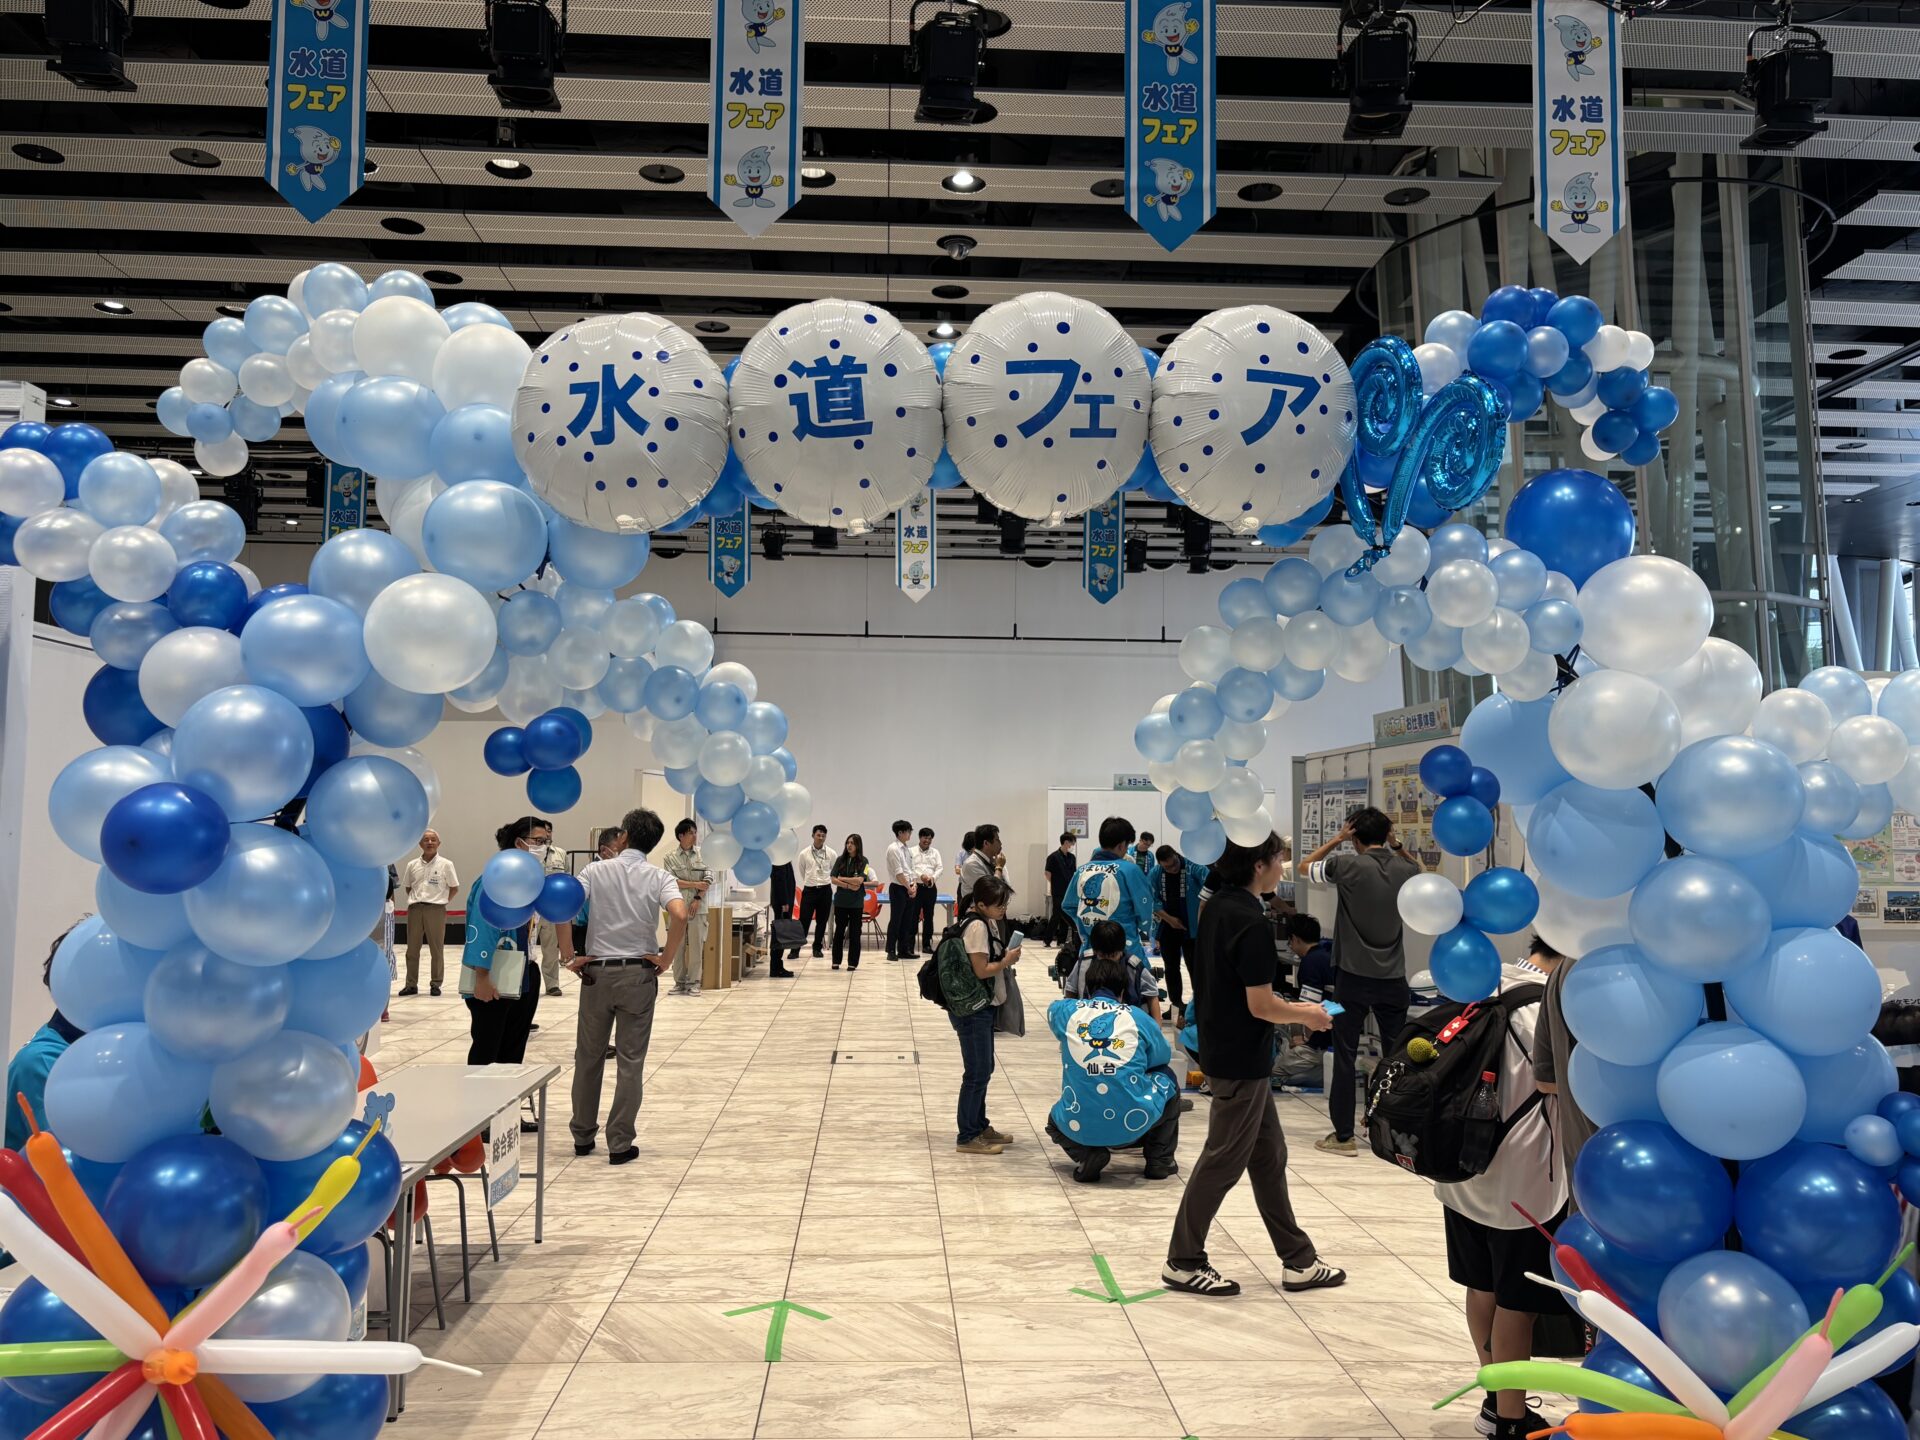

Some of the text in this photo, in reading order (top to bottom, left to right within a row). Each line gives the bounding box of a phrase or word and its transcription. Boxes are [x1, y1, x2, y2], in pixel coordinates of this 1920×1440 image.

[288, 47, 347, 80] 水道
[729, 67, 783, 96] 水道
[287, 84, 346, 112] フェア
[1142, 82, 1198, 113] 水道
[727, 102, 785, 130] フェア
[1552, 95, 1603, 123] 水道
[1142, 118, 1198, 145] フェア
[1550, 129, 1606, 157] フェア
[566, 354, 1322, 446] 水 道 フェ ア
[331, 509, 358, 524] 水道
[717, 520, 742, 534] 水道
[716, 536, 742, 549] フェア
[904, 525, 928, 539] 水道
[1091, 528, 1116, 543] 水道
[903, 541, 929, 554] フェア
[1091, 544, 1117, 557] フェア
[1079, 863, 1118, 874] うまい水
[1086, 1062, 1116, 1075] 仙台
